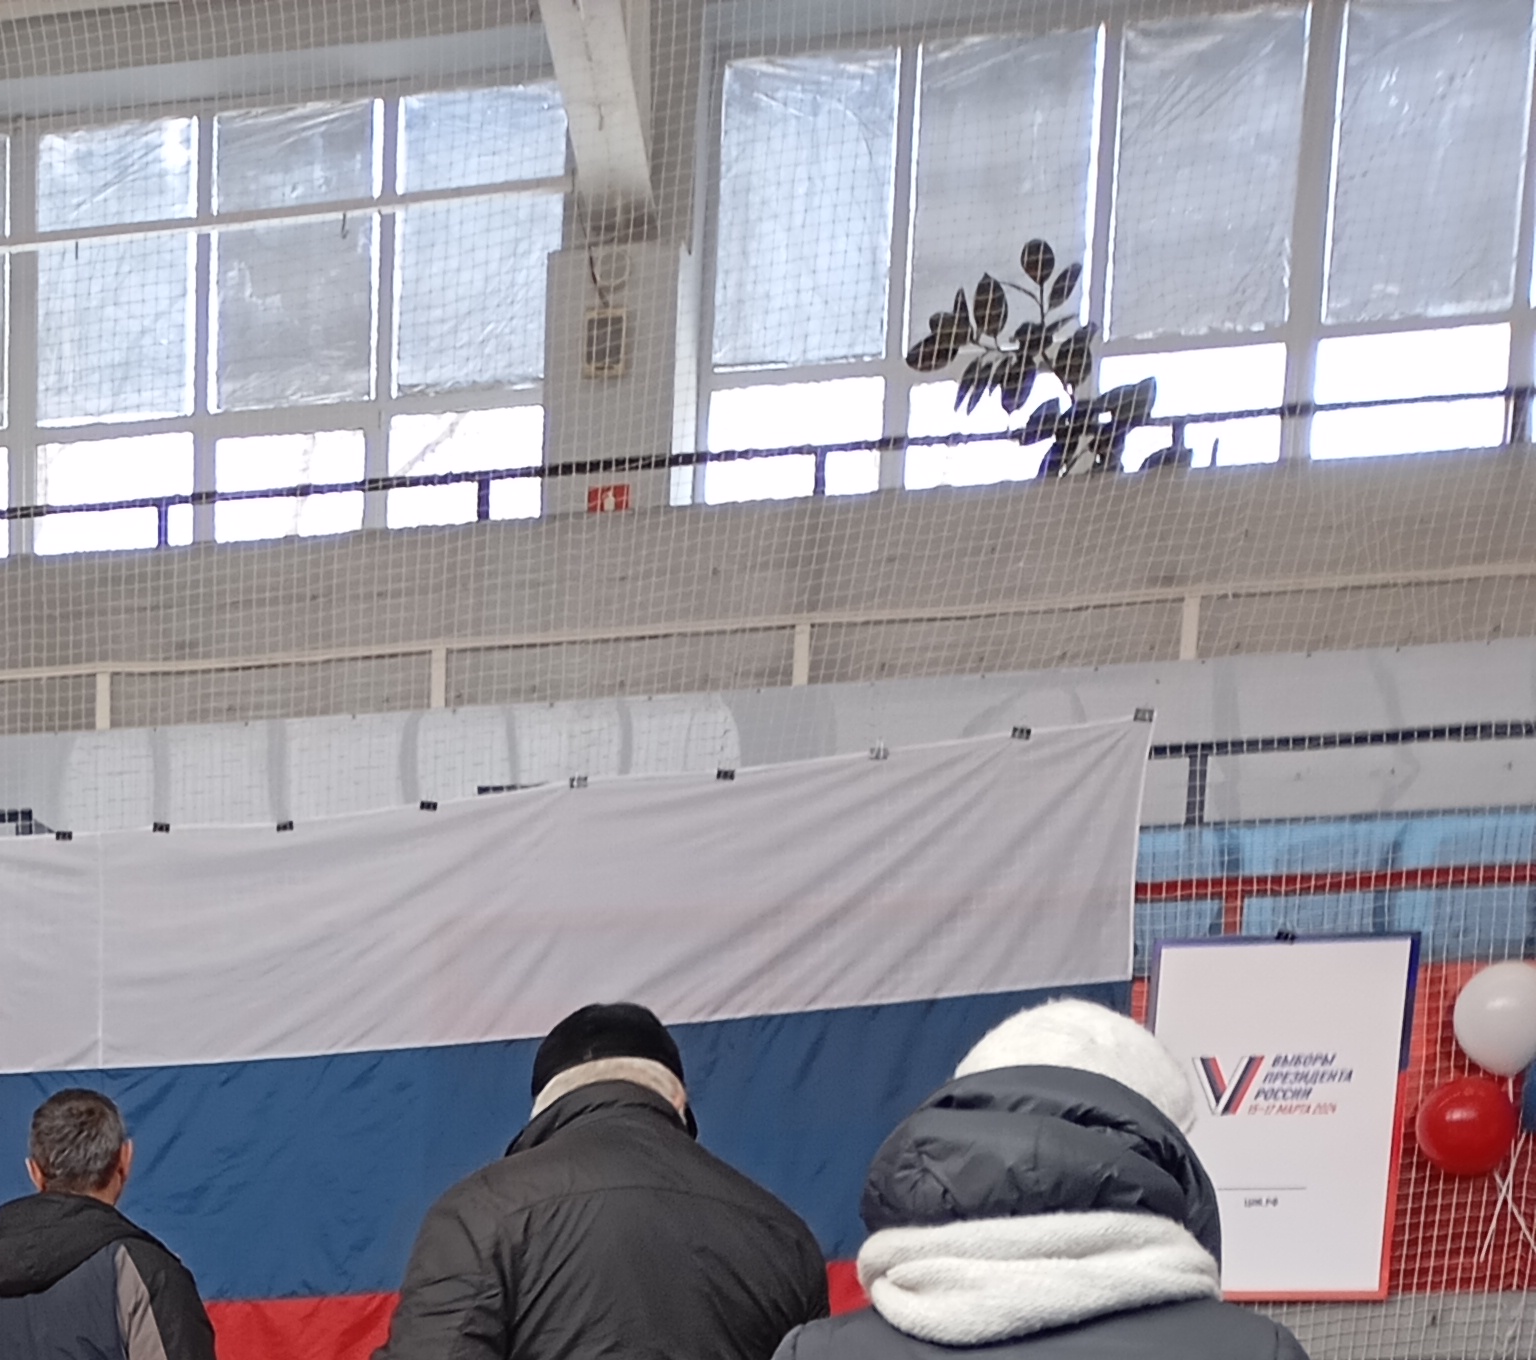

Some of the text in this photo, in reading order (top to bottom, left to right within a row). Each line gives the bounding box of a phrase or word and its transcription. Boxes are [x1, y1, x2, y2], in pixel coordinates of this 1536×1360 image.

[1272, 1053, 1336, 1067] ВЫБОРЫ
[1263, 1069, 1353, 1085] ПРЕЗИДЕНТА
[1254, 1087, 1313, 1101] РОССИИ
